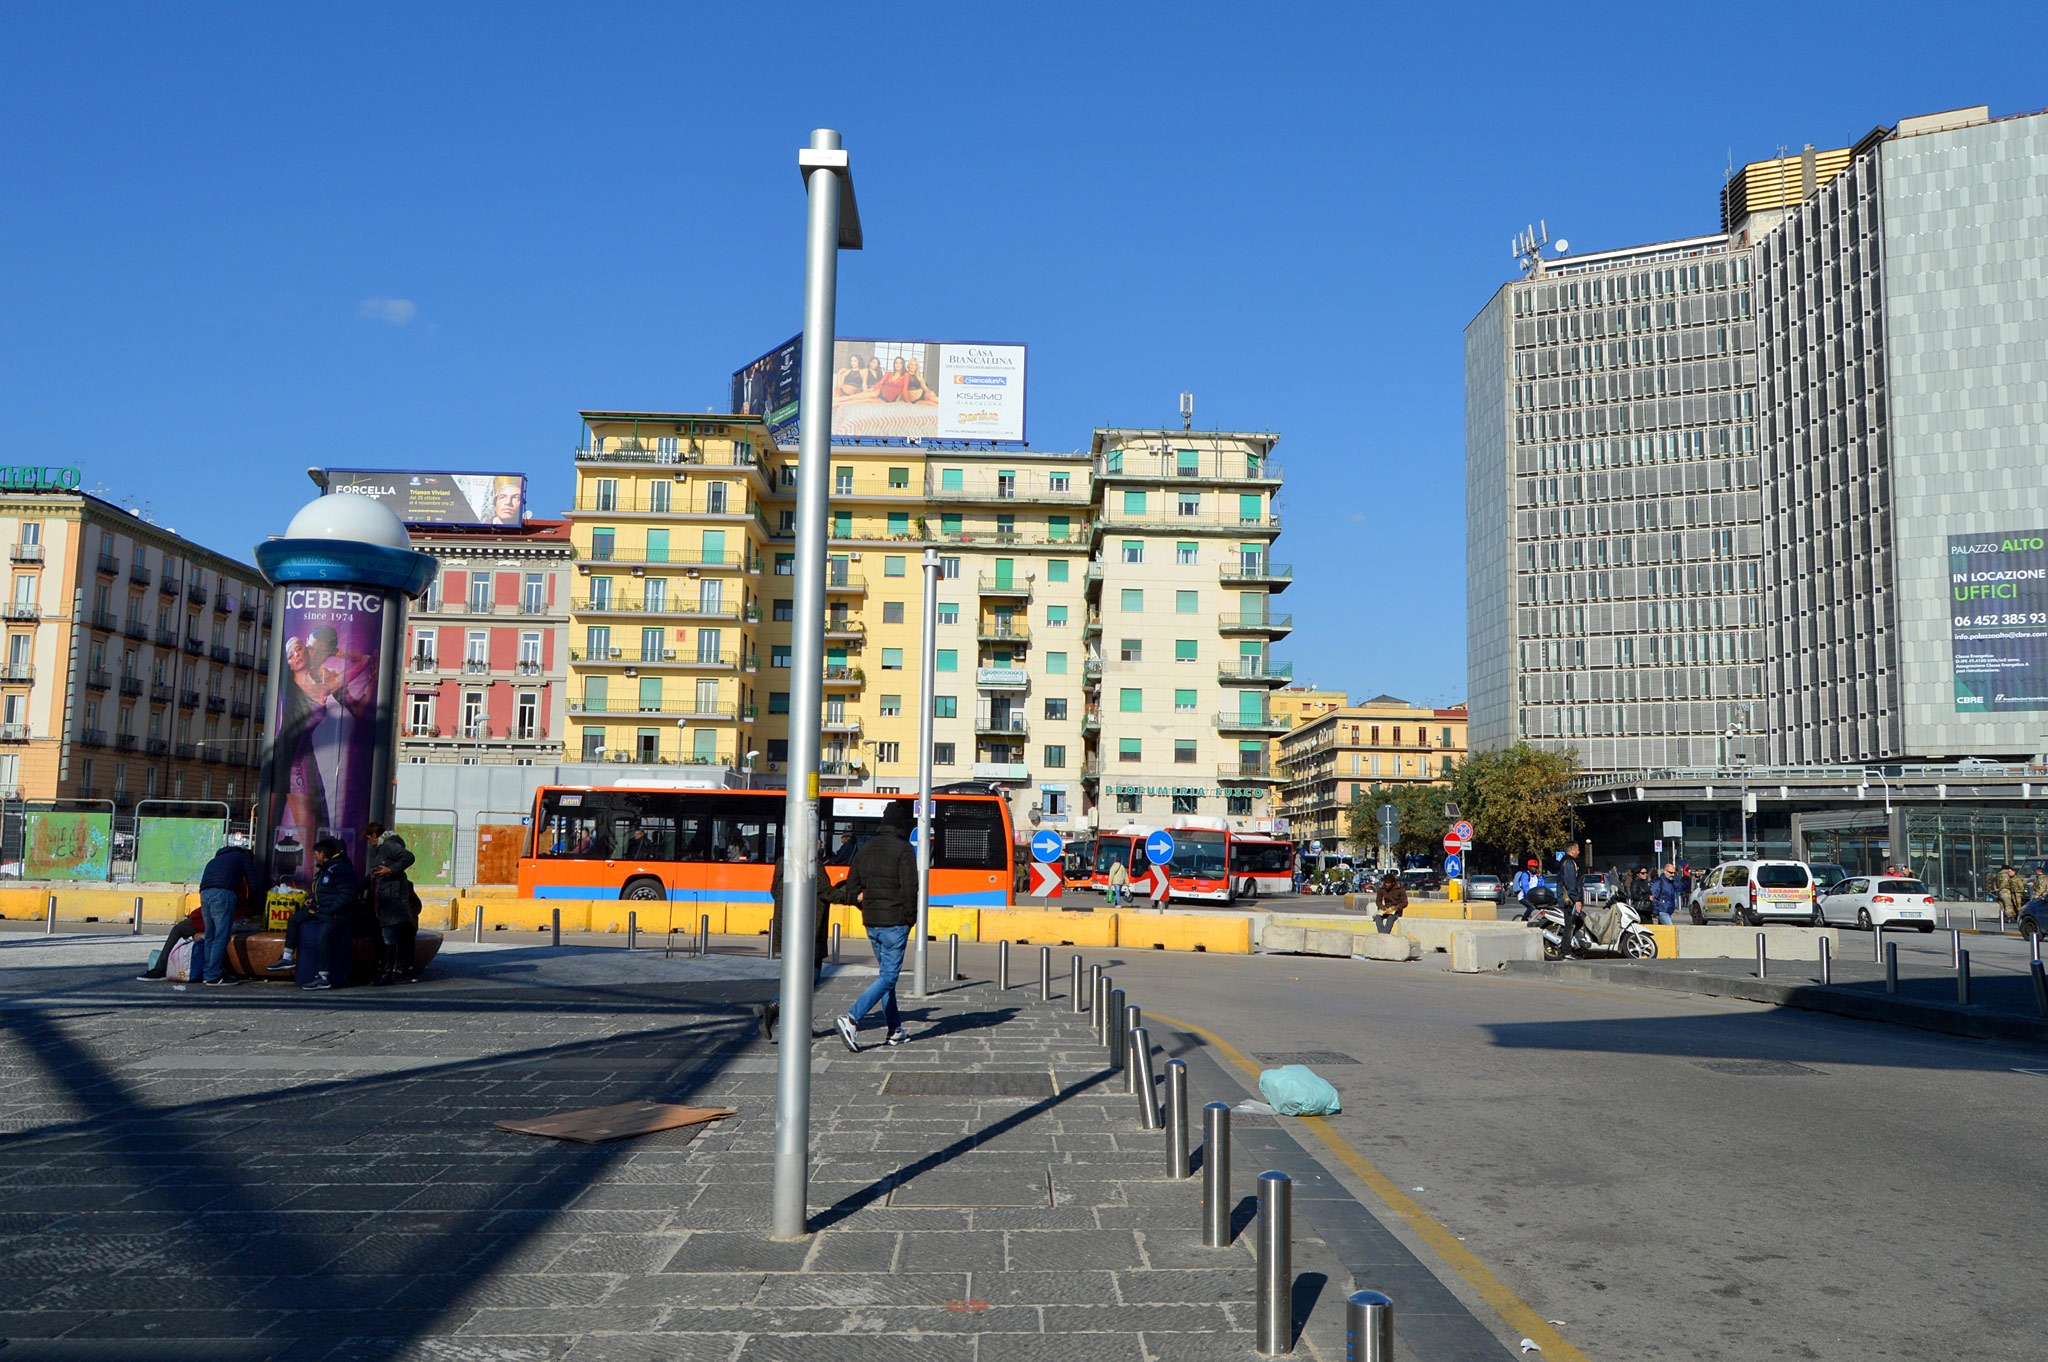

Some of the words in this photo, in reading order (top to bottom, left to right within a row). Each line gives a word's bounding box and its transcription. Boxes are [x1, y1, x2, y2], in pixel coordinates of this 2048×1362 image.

[968, 348, 994, 357] CASA
[949, 355, 1013, 365] BIANCALUNA
[956, 392, 1003, 401] KISSIMO
[335, 485, 396, 495] FORCELLA
[1951, 543, 1999, 555] PALAZZO
[2001, 537, 2045, 552] ALTO
[1953, 573, 1967, 583] IN
[1971, 569, 2046, 582] LOCAZIONE
[1954, 583, 2017, 601] UFFICI
[285, 590, 381, 613] ICEBERG
[303, 612, 327, 620] since
[331, 613, 354, 622] 1974
[1954, 616, 1971, 627] 06
[1974, 615, 1998, 626] 452
[2001, 613, 2026, 625] 385
[2029, 612, 2047, 624] 93
[1954, 631, 2047, 641] info.palazzoalto@cbre.com
[1956, 696, 1984, 704] CBRE
[1105, 785, 1206, 797] PROFUMERIA
[1215, 787, 1264, 798] FUSCO
